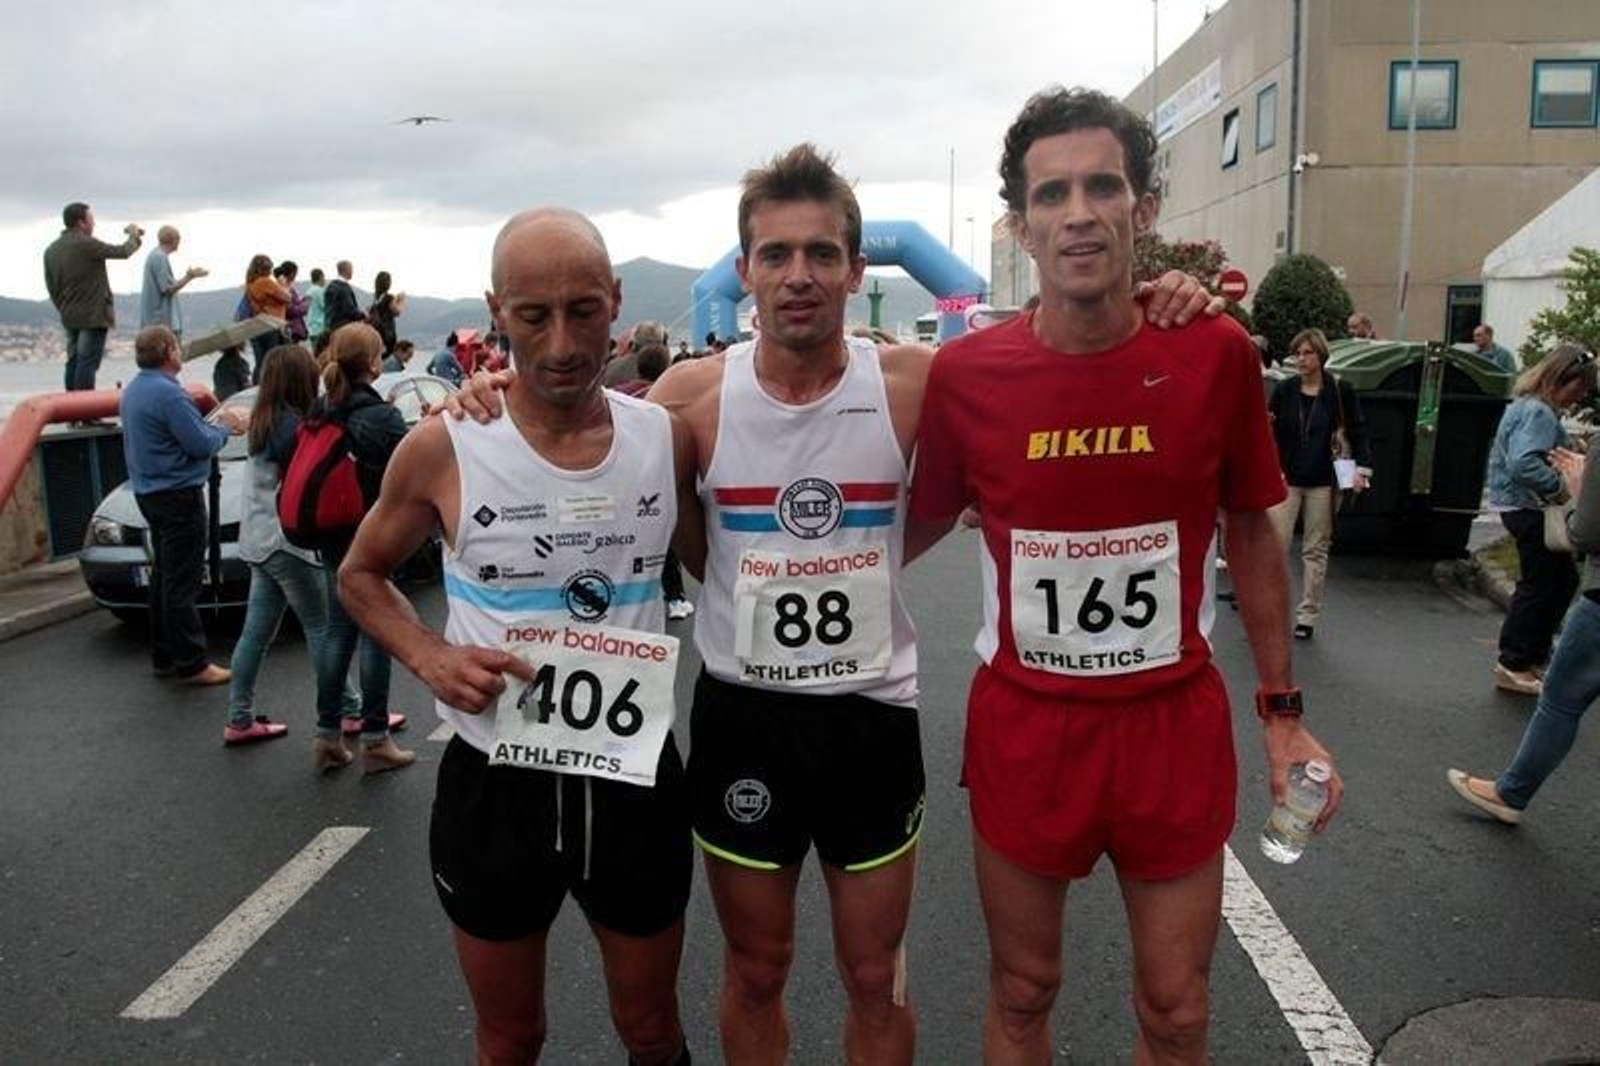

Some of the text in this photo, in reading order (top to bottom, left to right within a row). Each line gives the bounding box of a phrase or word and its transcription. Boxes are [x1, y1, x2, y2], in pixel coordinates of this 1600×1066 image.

[1027, 425, 1155, 461] BIKILA
[1014, 532, 1169, 560] new balance
[741, 551, 880, 577] new balance
[1035, 570, 1158, 635] 165
[774, 590, 853, 648] 88
[506, 627, 668, 662] new balance
[1023, 648, 1146, 671] ATHLETICS
[744, 660, 859, 681] ATHLETICS
[517, 663, 645, 738] 406
[495, 743, 622, 773] ATHLETICS
